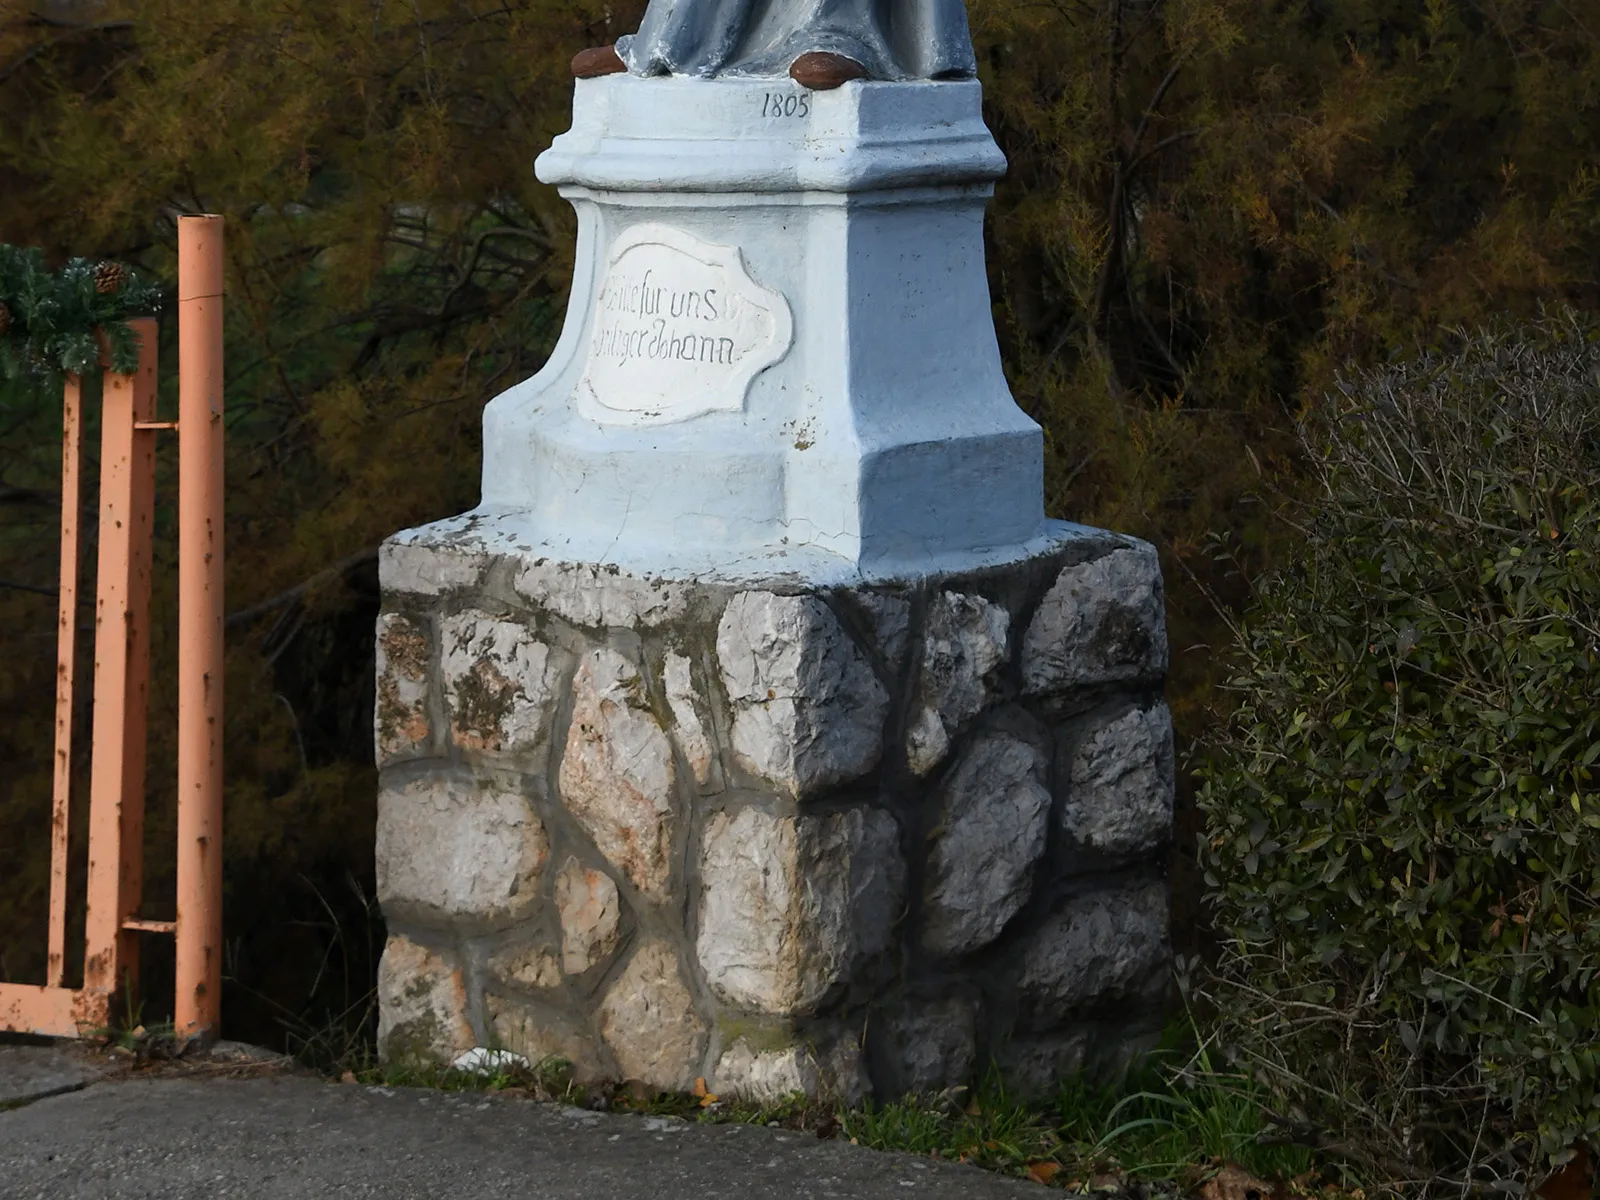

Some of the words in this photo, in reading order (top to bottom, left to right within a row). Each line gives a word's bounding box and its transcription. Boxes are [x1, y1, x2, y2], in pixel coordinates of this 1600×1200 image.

[762, 93, 809, 118] 1805
[670, 288, 717, 321] uns
[648, 318, 733, 365] Johann
